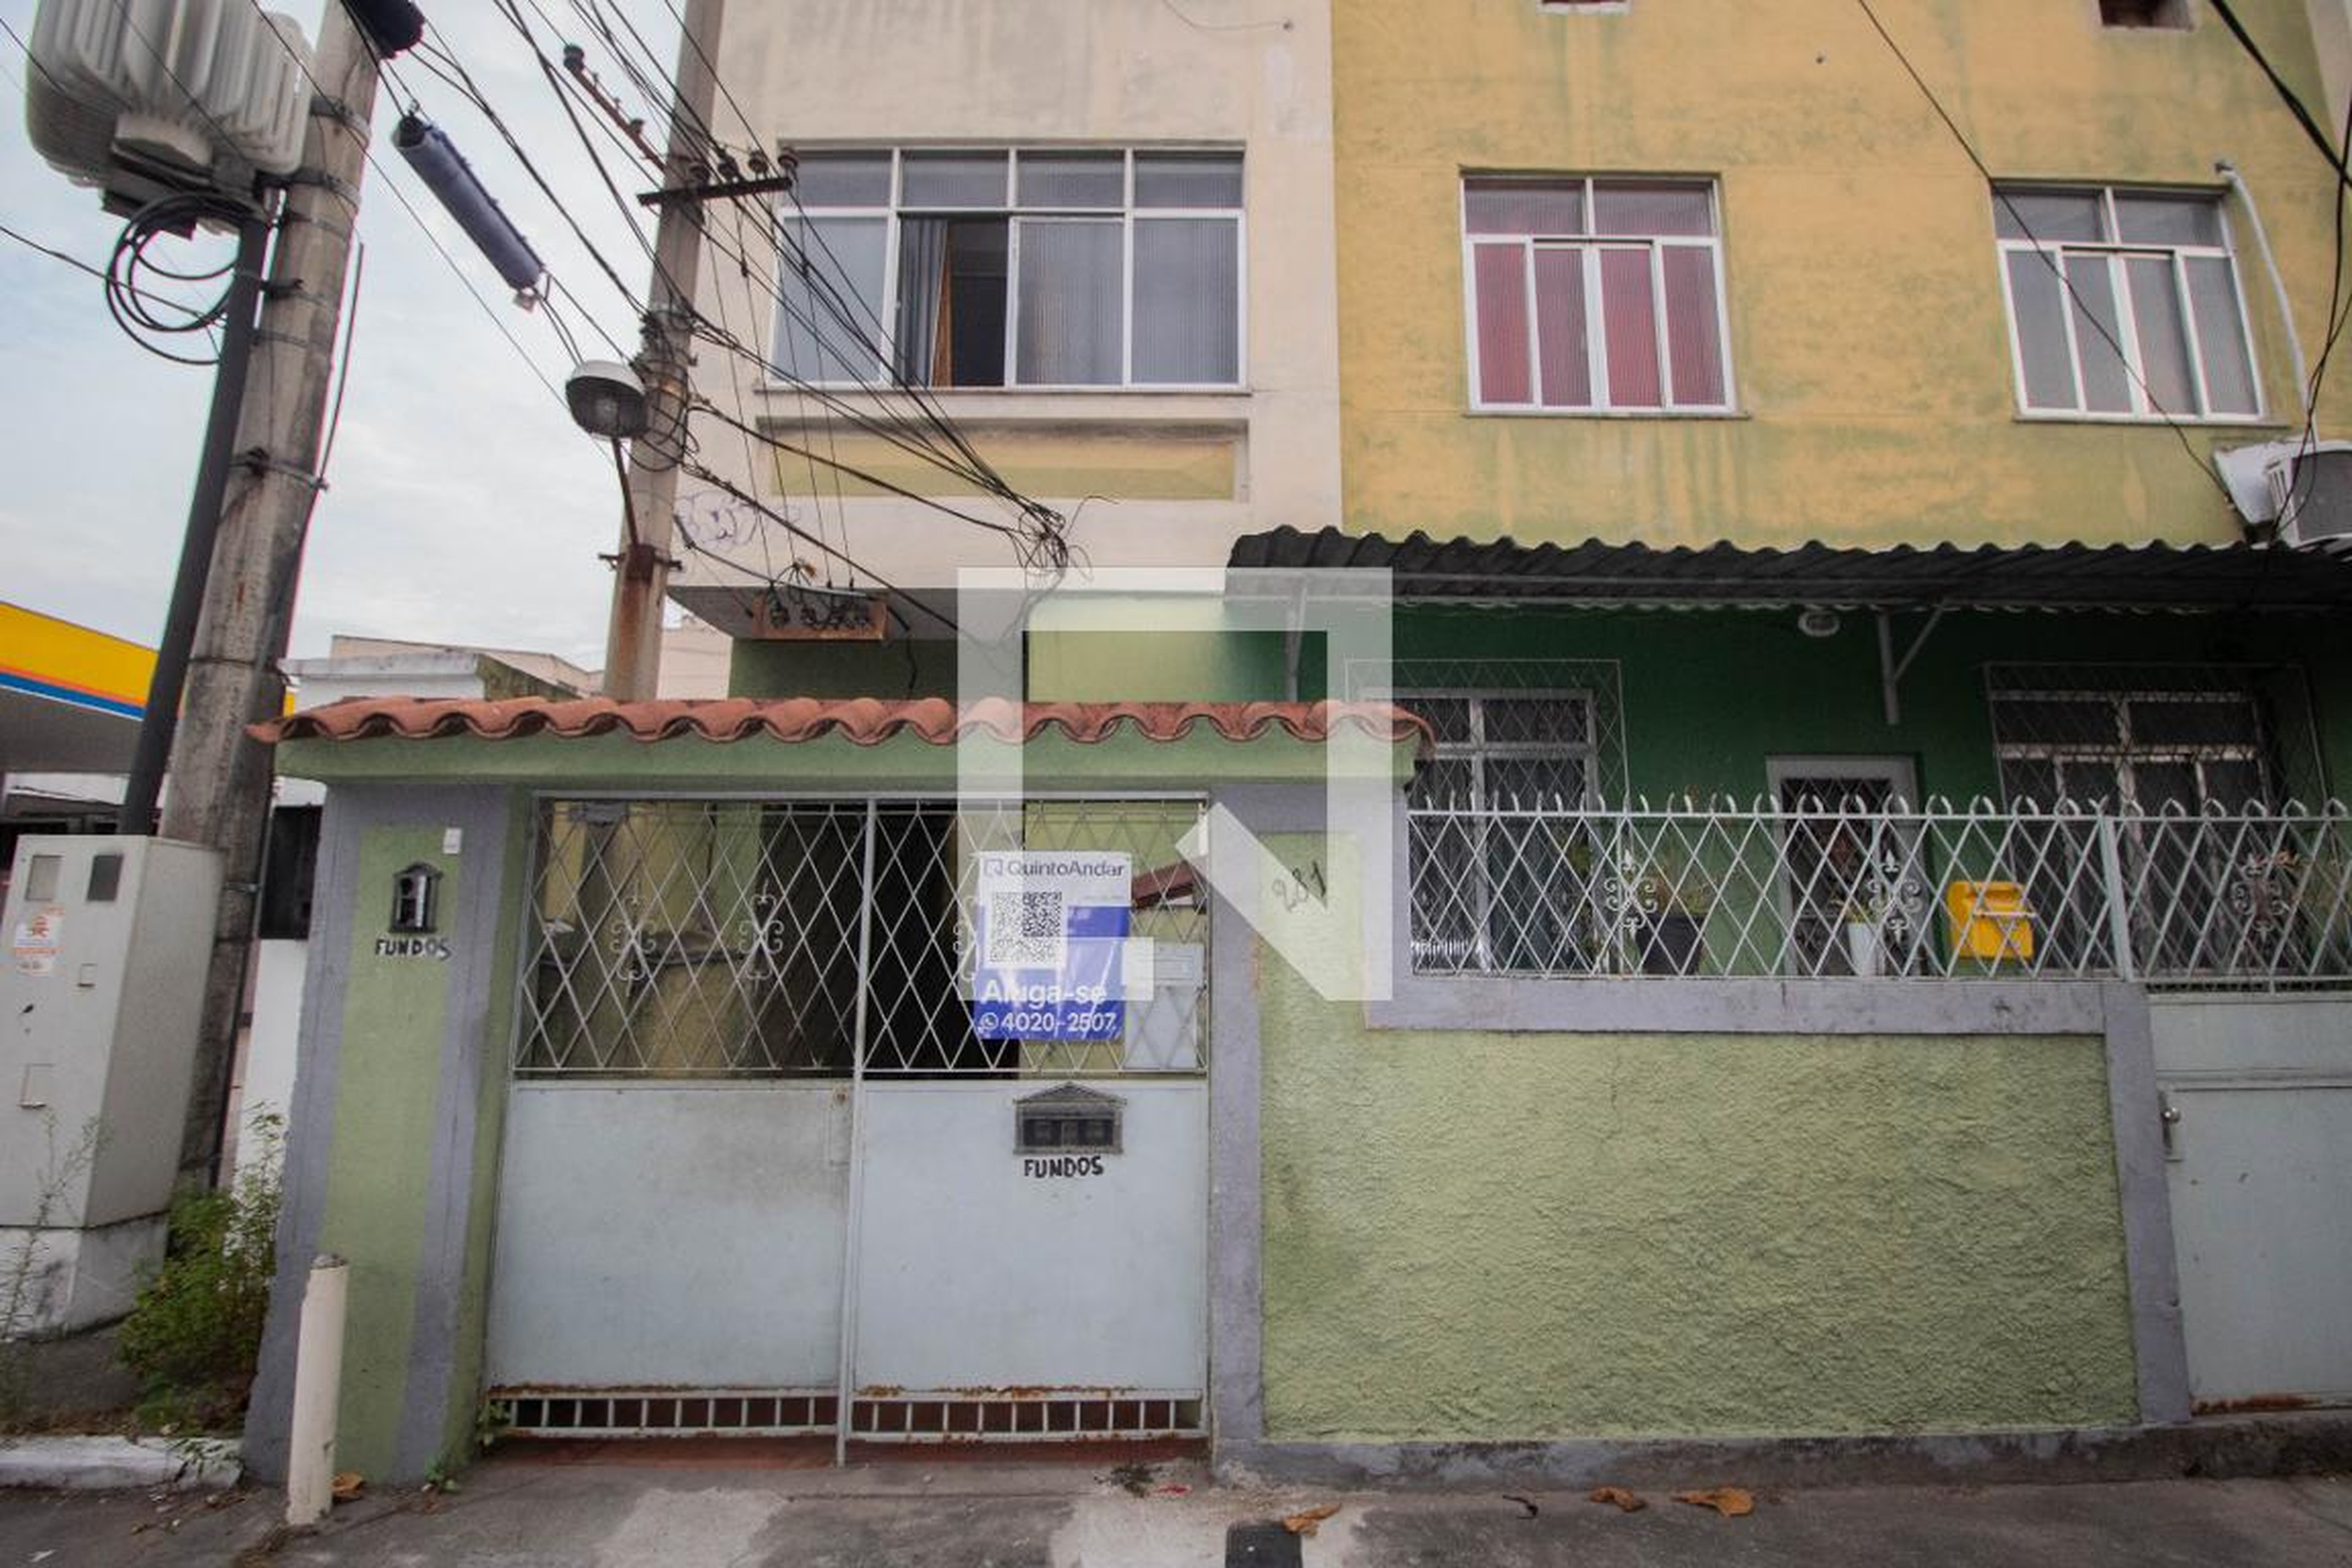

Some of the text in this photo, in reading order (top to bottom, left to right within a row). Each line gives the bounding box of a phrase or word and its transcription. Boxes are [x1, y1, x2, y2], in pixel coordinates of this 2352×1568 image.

[1008, 860, 1124, 878] QuintoAndar
[374, 938, 453, 961] FUNDOS
[1023, 1155, 1104, 1178] FUNDOS
